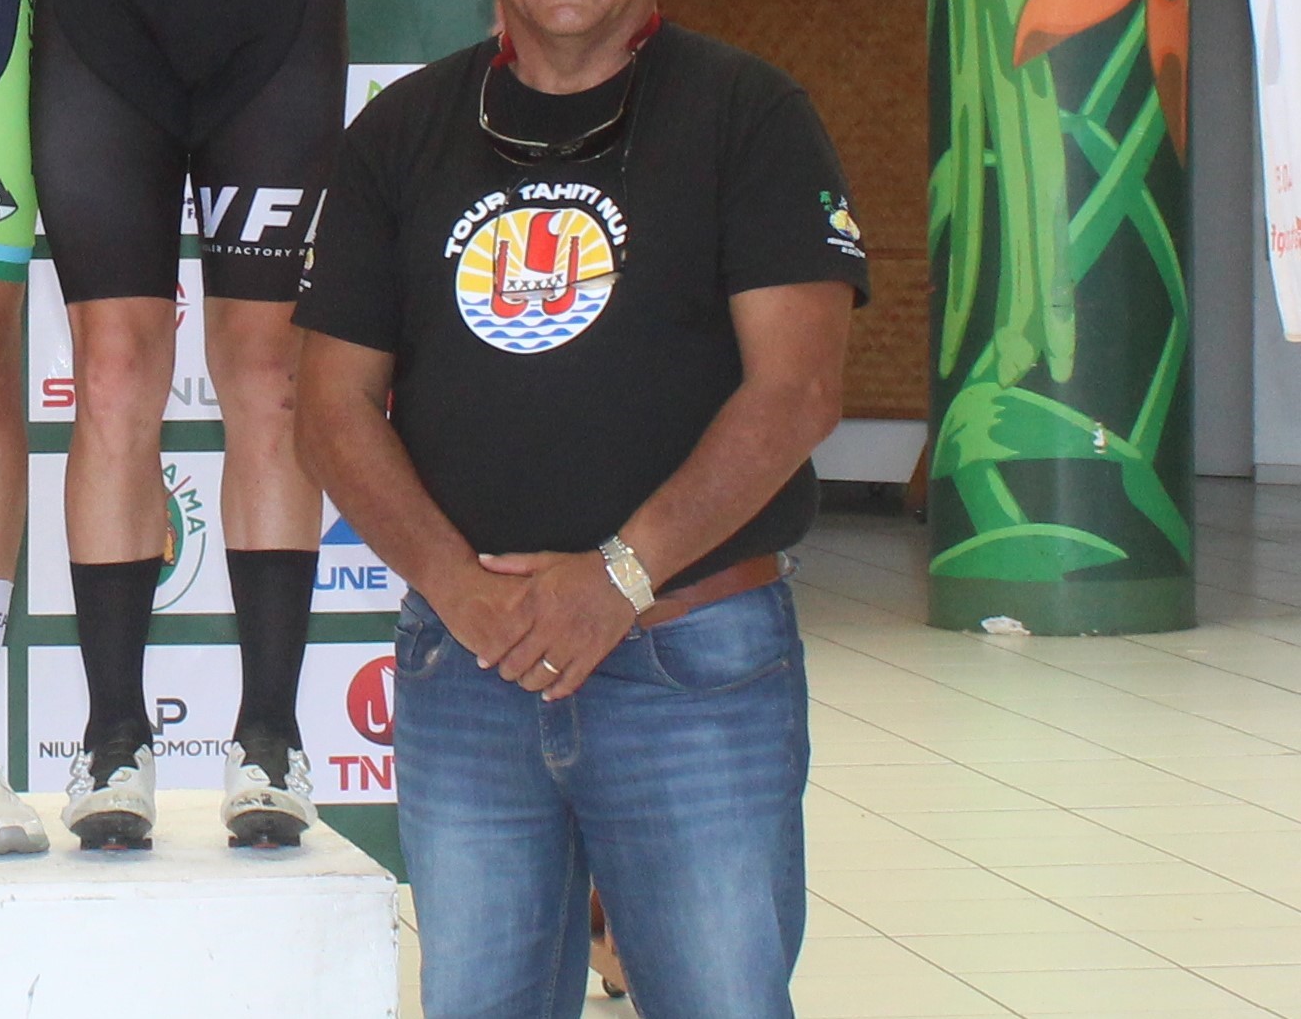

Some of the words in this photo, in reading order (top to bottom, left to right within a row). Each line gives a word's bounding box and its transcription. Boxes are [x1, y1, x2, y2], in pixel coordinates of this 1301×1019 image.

[444, 192, 508, 258] TOUR
[519, 182, 602, 205] TAHITI
[596, 197, 628, 246] NUI
[227, 246, 293, 257] FACTORY
